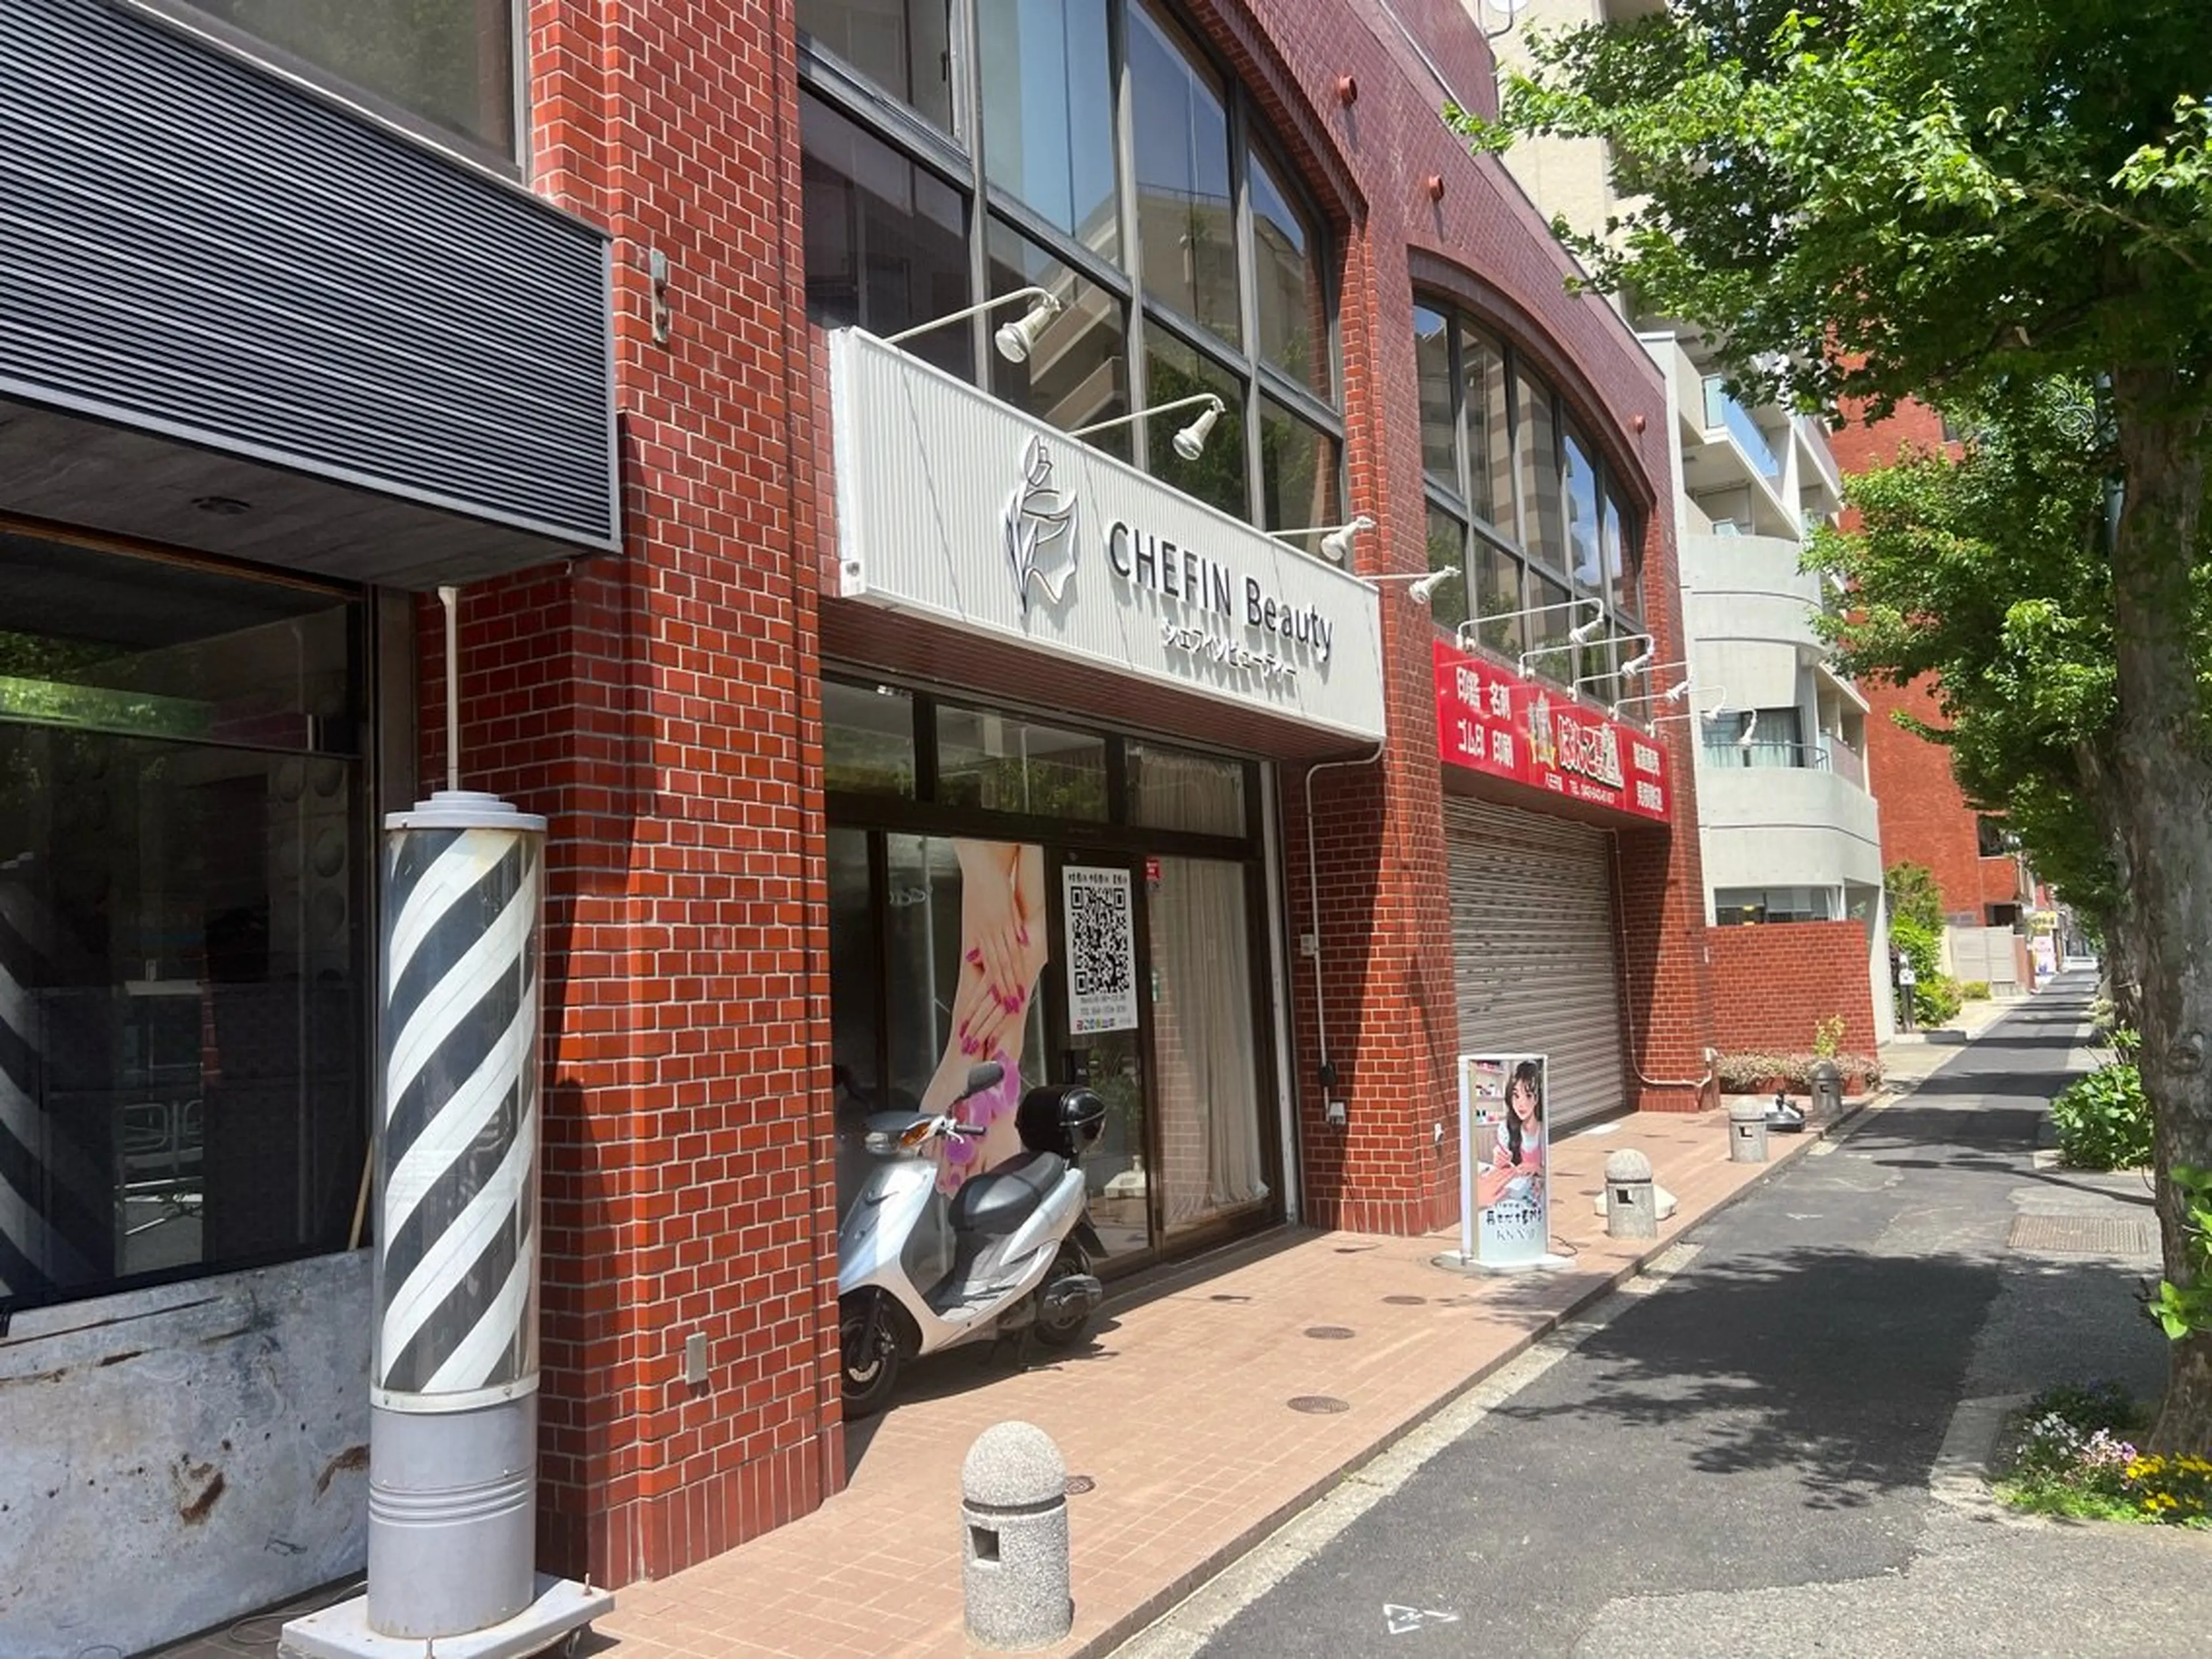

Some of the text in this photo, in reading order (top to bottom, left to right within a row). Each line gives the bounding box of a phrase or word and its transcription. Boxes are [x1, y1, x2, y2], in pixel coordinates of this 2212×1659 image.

[1108, 520, 1334, 662] CHEFIN Beauty
[1457, 718, 1486, 759] ゴム印
